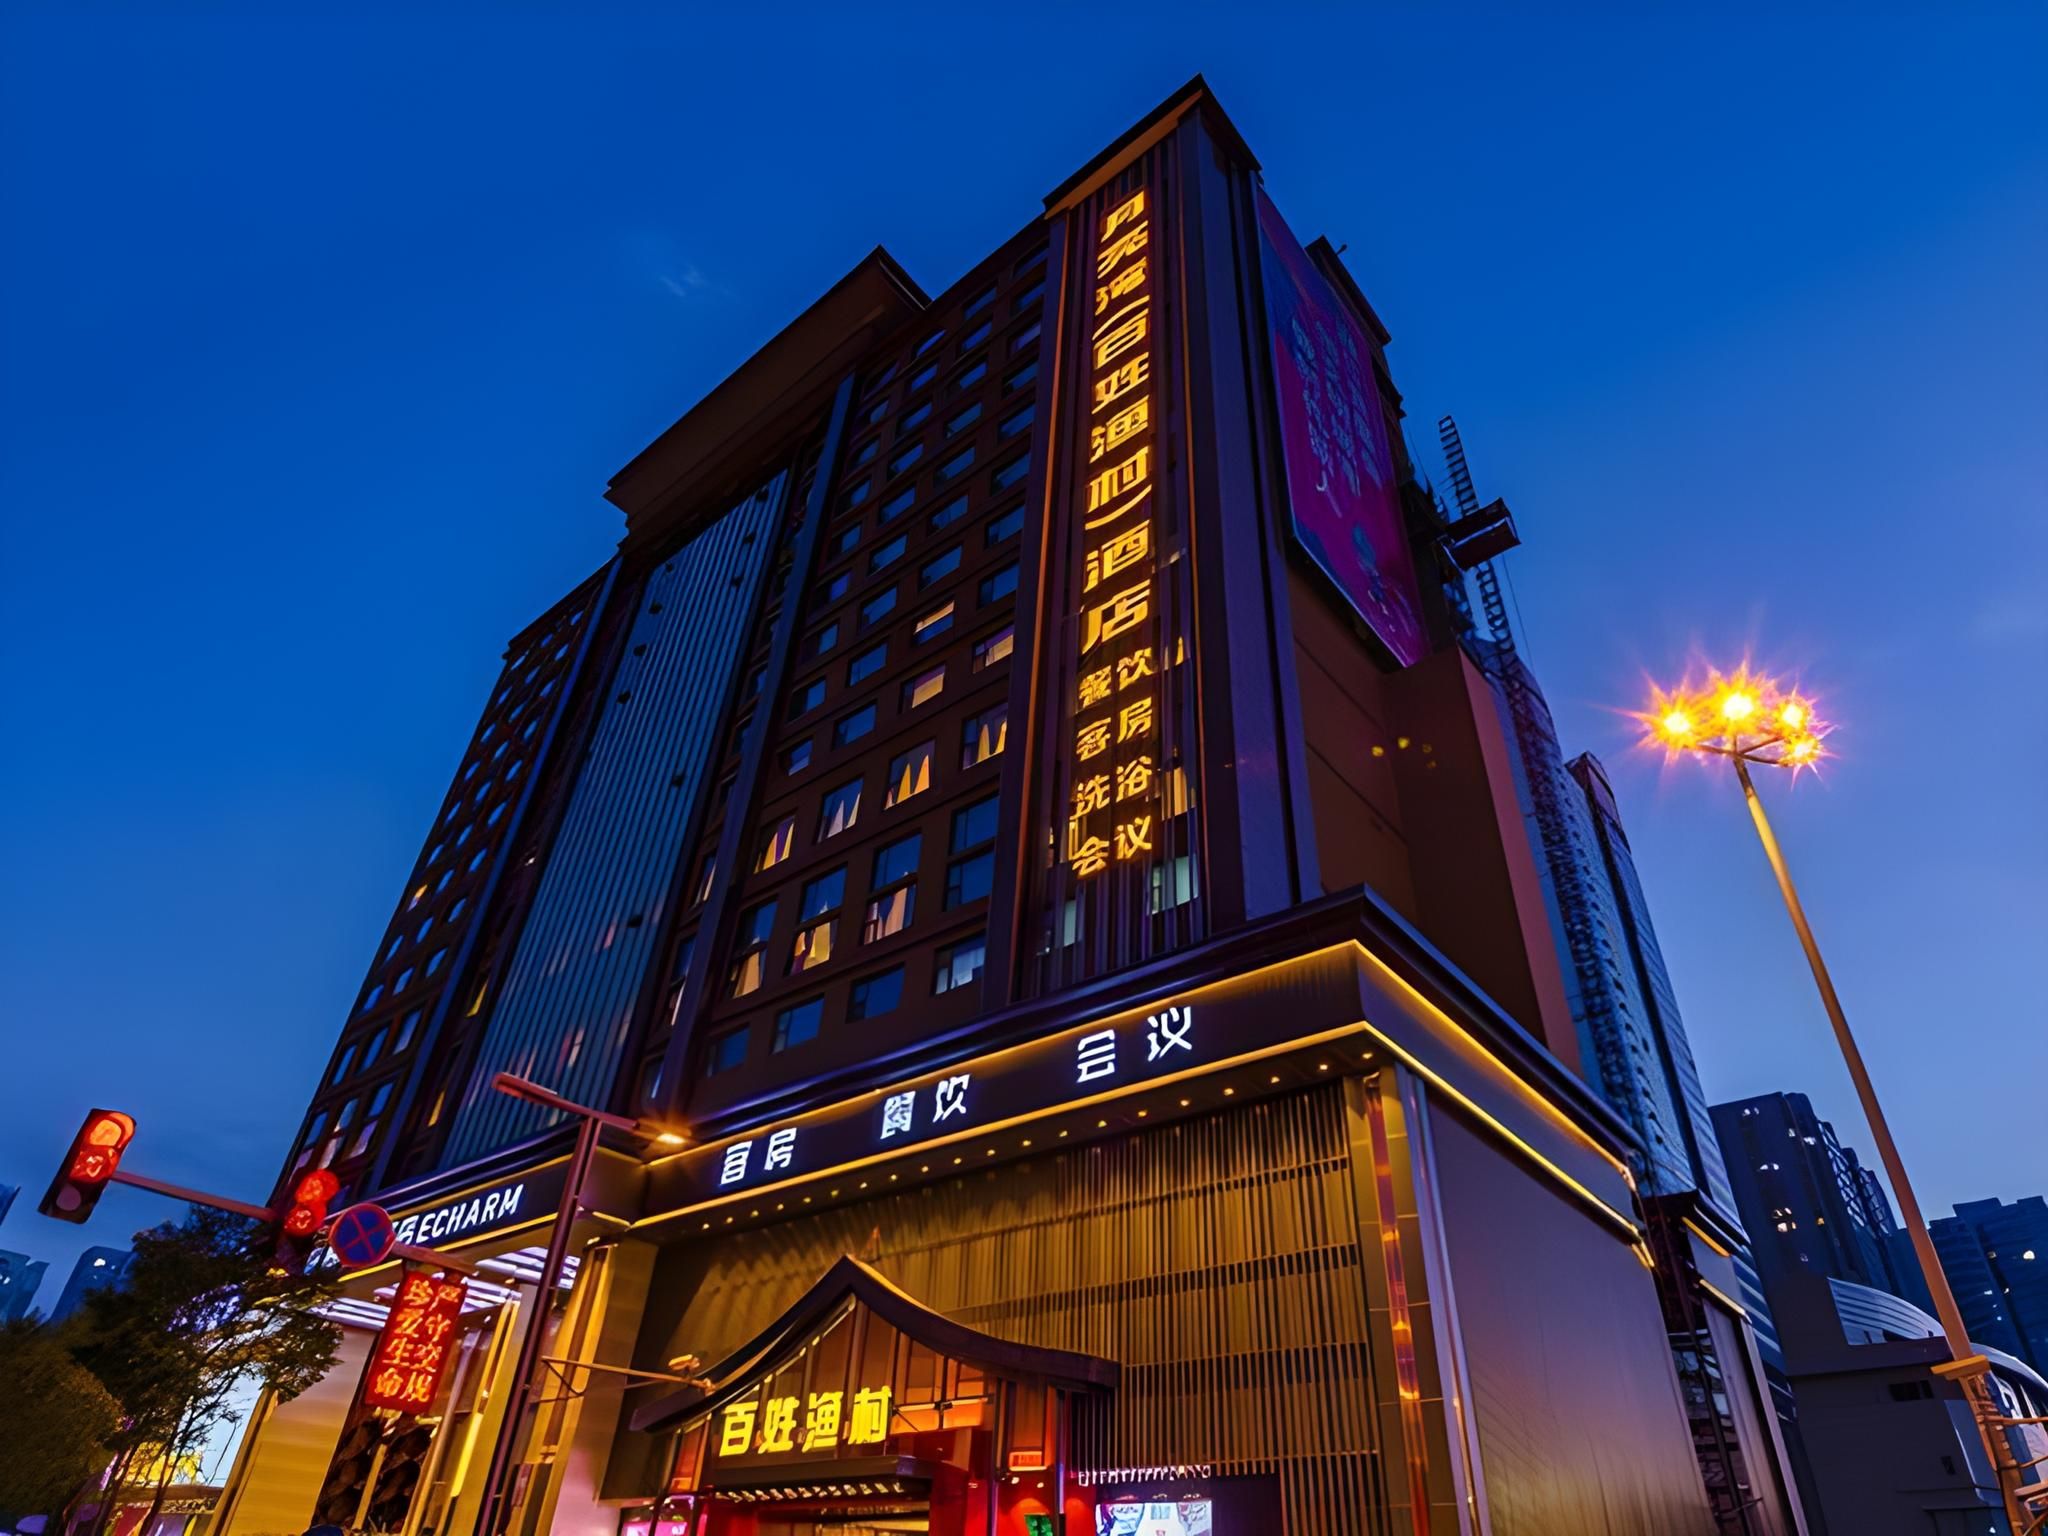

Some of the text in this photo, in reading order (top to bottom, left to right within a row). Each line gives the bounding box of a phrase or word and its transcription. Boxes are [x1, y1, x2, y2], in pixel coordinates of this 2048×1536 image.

[1071, 756, 1152, 819] 洗浴
[1072, 815, 1152, 876] 会议
[719, 1385, 892, 1457] 百姓渔村
